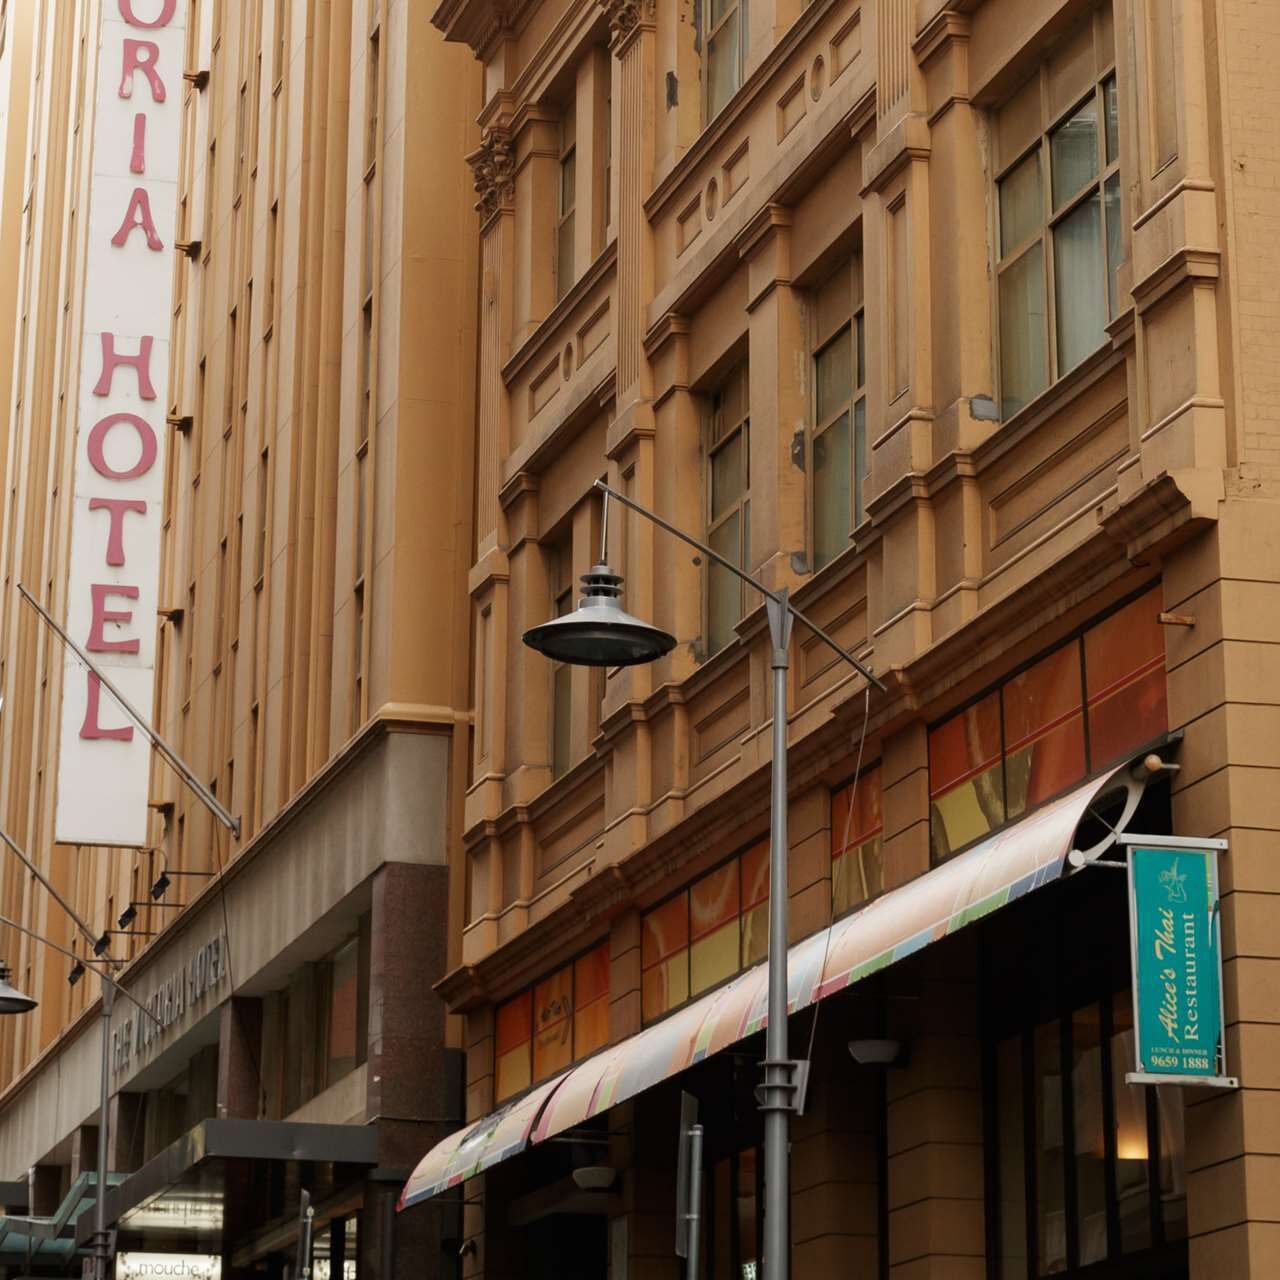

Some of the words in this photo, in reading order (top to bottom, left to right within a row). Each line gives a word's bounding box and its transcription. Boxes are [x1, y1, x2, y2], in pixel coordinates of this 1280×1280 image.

[78, 331, 158, 742] HOTEL
[1154, 907, 1177, 961] Thai
[1158, 967, 1180, 1043] Alice's
[1182, 912, 1199, 1041] Restaurant
[1151, 1055, 1179, 1067] 9659
[1182, 1056, 1209, 1070] 1888
[138, 1259, 200, 1277] mouche
